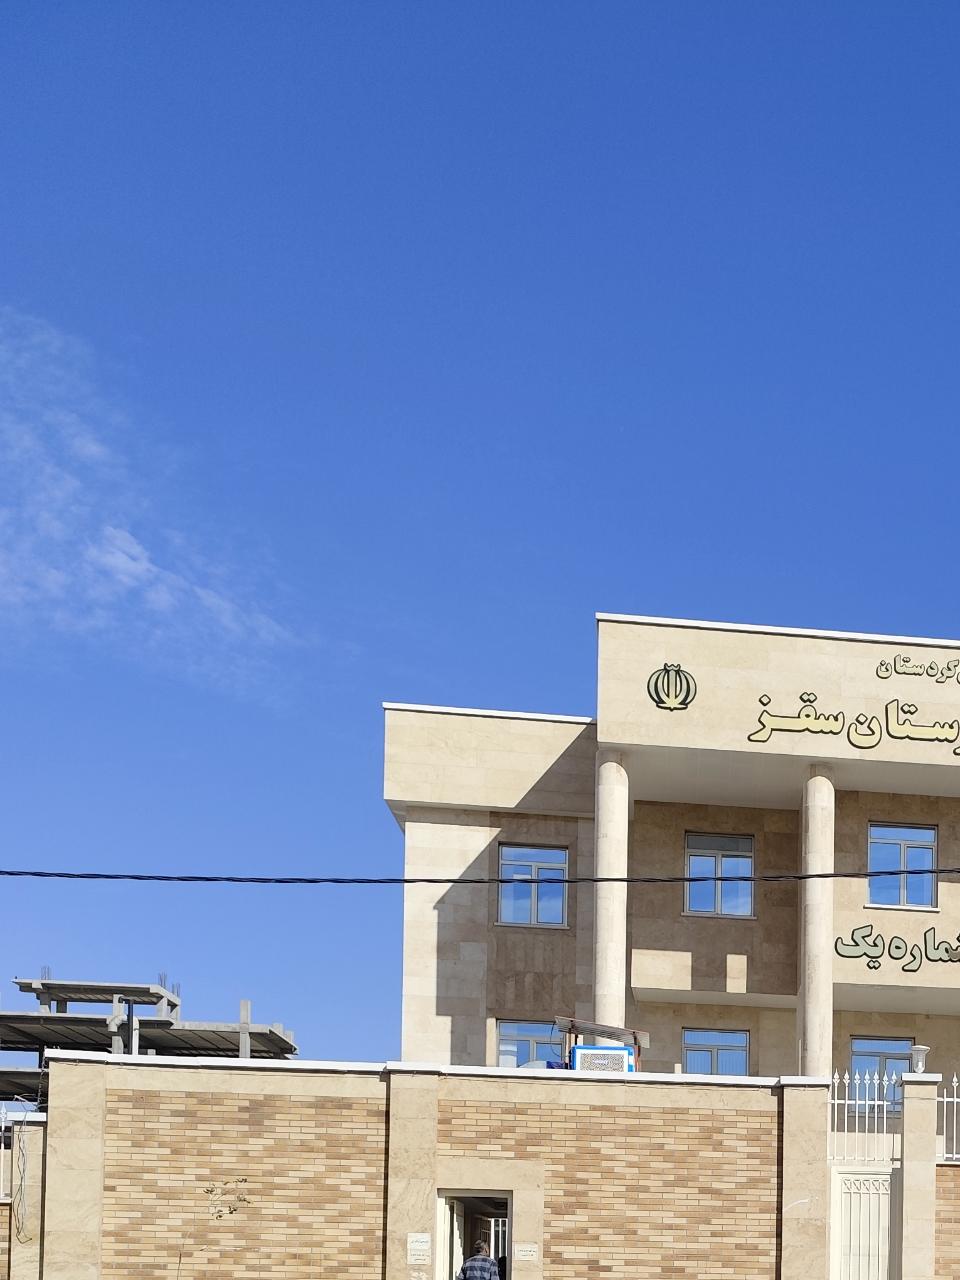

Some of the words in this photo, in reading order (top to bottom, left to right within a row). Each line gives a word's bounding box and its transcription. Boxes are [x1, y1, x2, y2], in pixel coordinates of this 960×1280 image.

[876, 653, 960, 684] کردستان
[747, 691, 846, 743] سقز
[834, 924, 886, 971] یک
